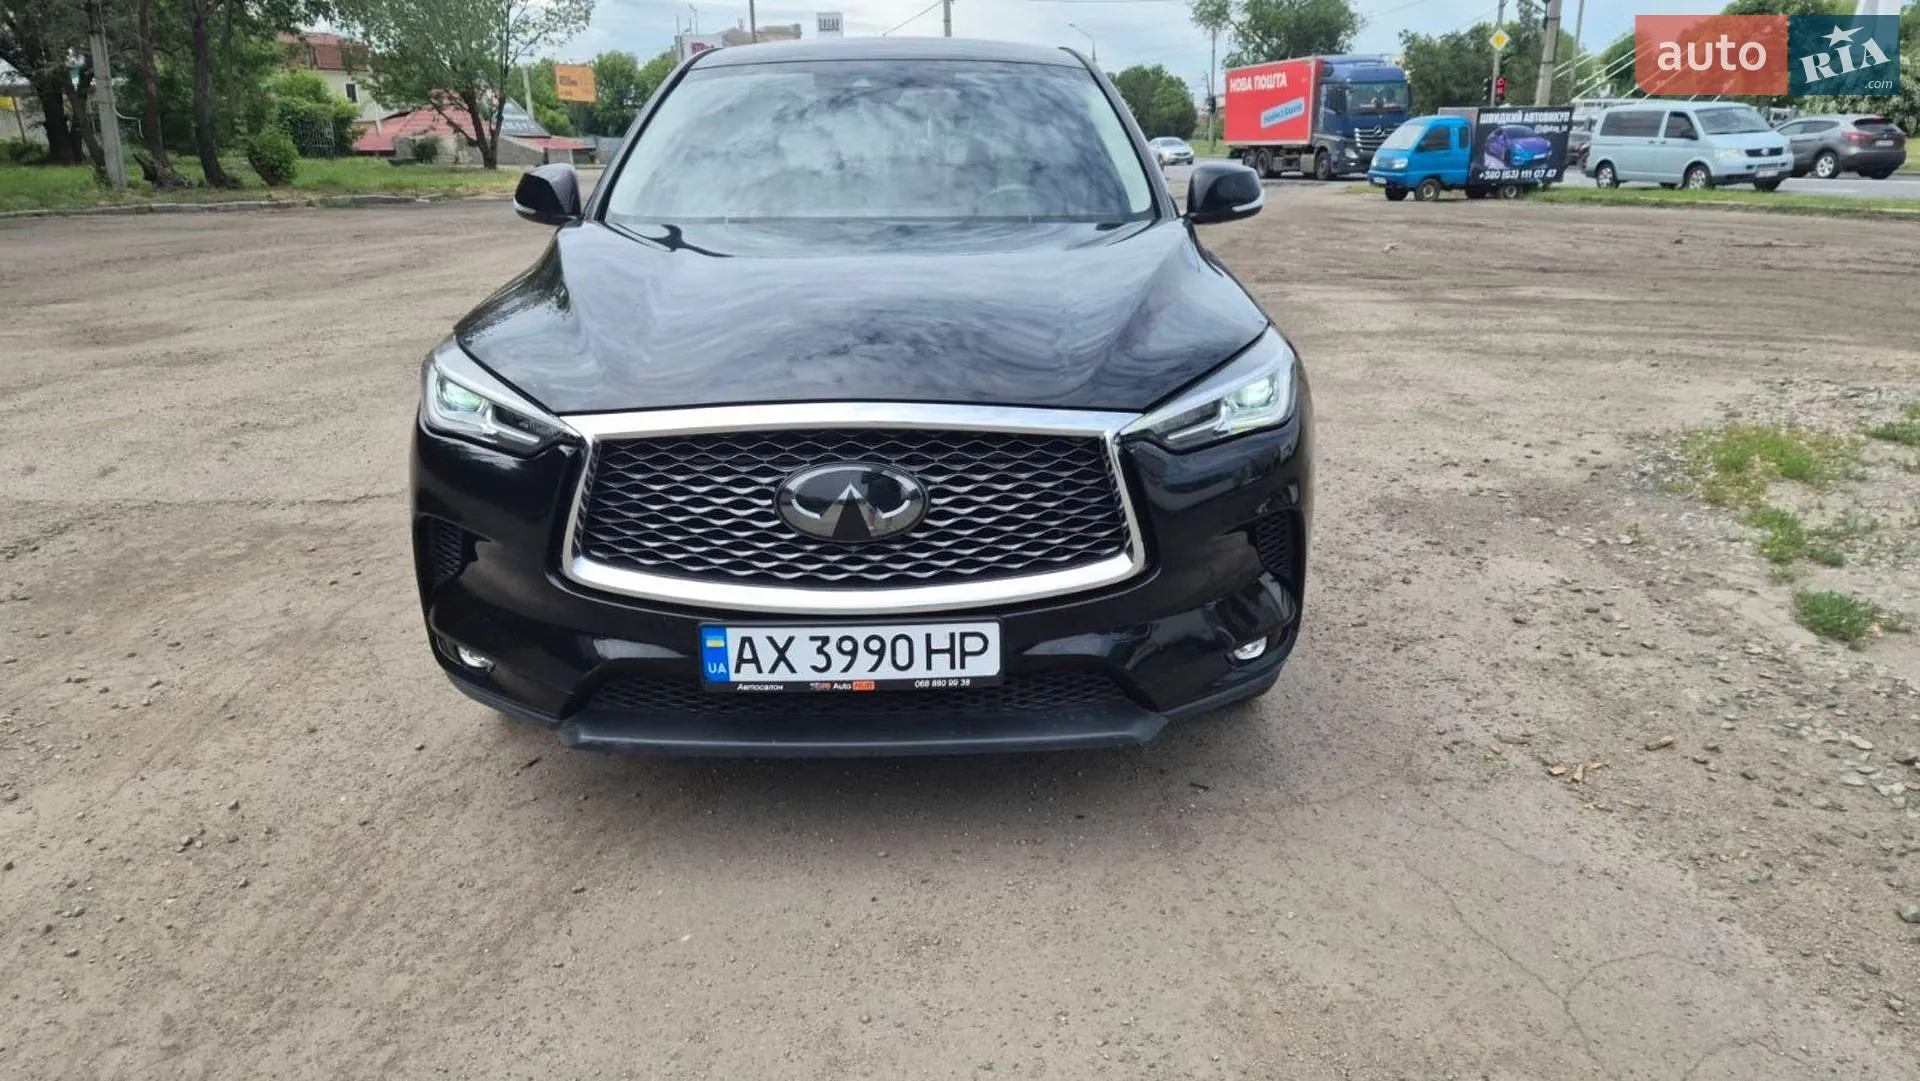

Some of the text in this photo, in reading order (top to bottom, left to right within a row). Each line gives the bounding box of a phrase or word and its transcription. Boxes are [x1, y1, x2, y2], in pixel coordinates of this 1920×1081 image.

[1229, 72, 1288, 93] НОВА ПОШТА
[1479, 110, 1523, 125] ШВИДКИЙ
[734, 631, 990, 676] AX 3990 HP
[707, 662, 727, 675] UA
[832, 681, 852, 691] Auto
